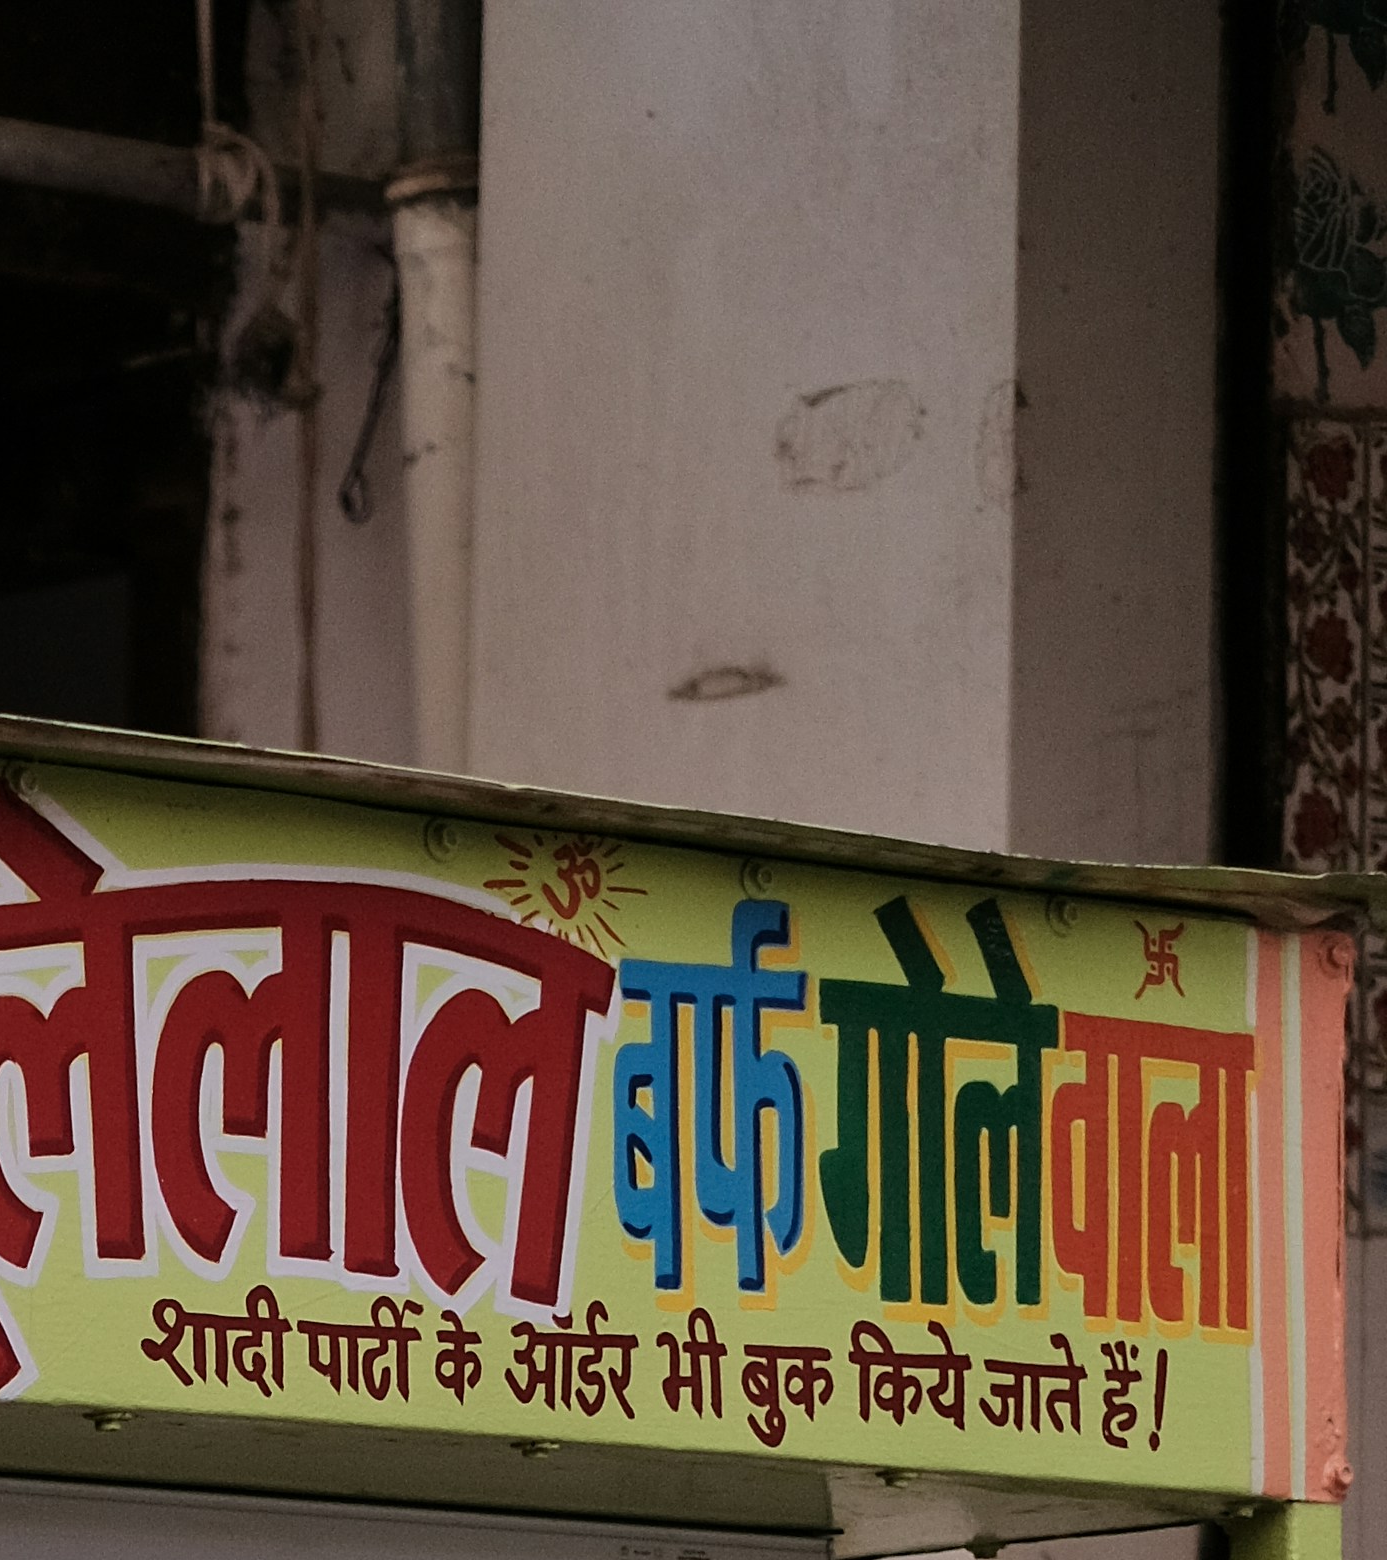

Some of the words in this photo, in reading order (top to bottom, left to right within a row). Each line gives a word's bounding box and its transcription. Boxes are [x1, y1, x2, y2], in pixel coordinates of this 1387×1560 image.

[614, 898, 809, 1293] बर्फ
[819, 895, 1059, 1307] गोले
[1052, 1010, 1256, 1332] वाला
[141, 1285, 292, 1398] शादी
[297, 1295, 424, 1403] पार्टी
[434, 1310, 482, 1406] के
[657, 1307, 727, 1419] भी
[741, 1336, 834, 1448] बुक
[848, 1322, 973, 1431] किये
[979, 1334, 1087, 1435] जाते
